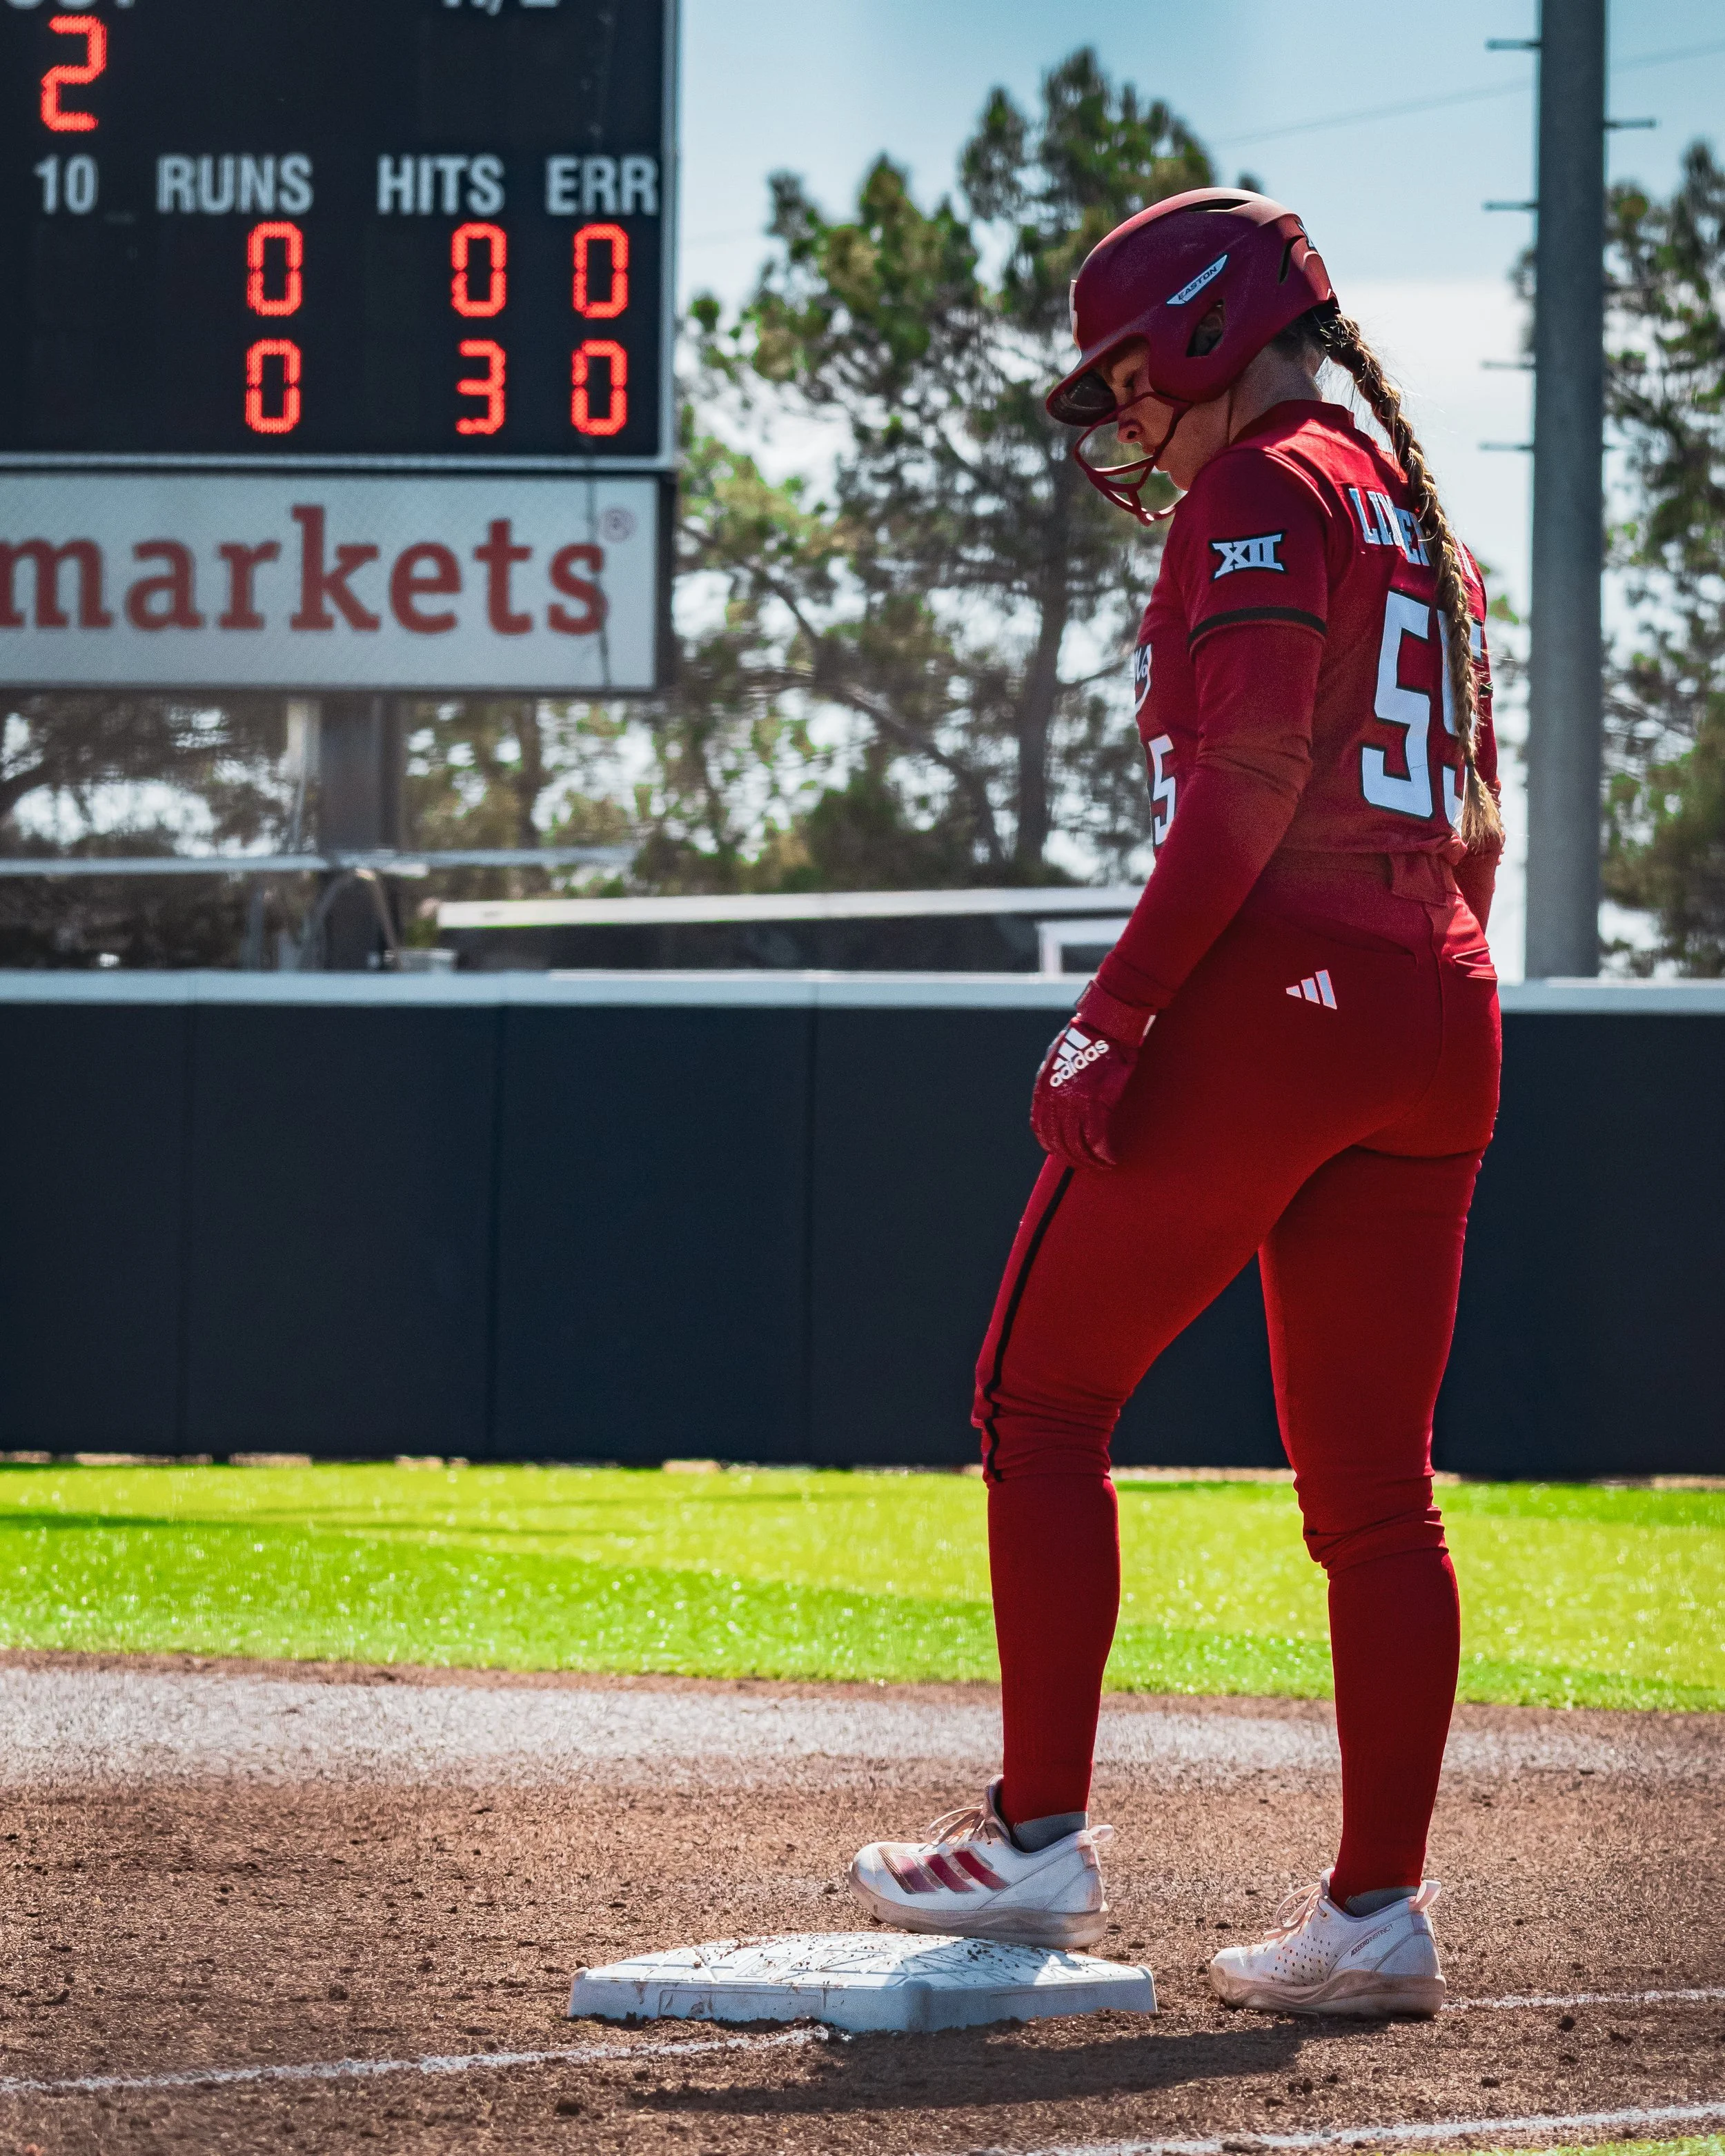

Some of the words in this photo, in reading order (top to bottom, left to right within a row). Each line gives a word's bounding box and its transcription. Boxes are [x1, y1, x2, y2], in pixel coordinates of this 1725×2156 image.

[41, 16, 106, 131] 2
[34, 155, 97, 214] 10
[157, 154, 313, 214] RUNS
[377, 155, 504, 215] HITS
[546, 156, 658, 215] ERR
[246, 221, 303, 317] 0
[451, 223, 507, 317] 0
[573, 224, 629, 319] 0
[1178, 266, 1218, 301] EASTON
[245, 339, 302, 434] 0
[456, 339, 506, 435] 3
[571, 339, 627, 435] 0
[1212, 533, 1285, 580] XII
[1049, 1040, 1110, 1087] adidas
